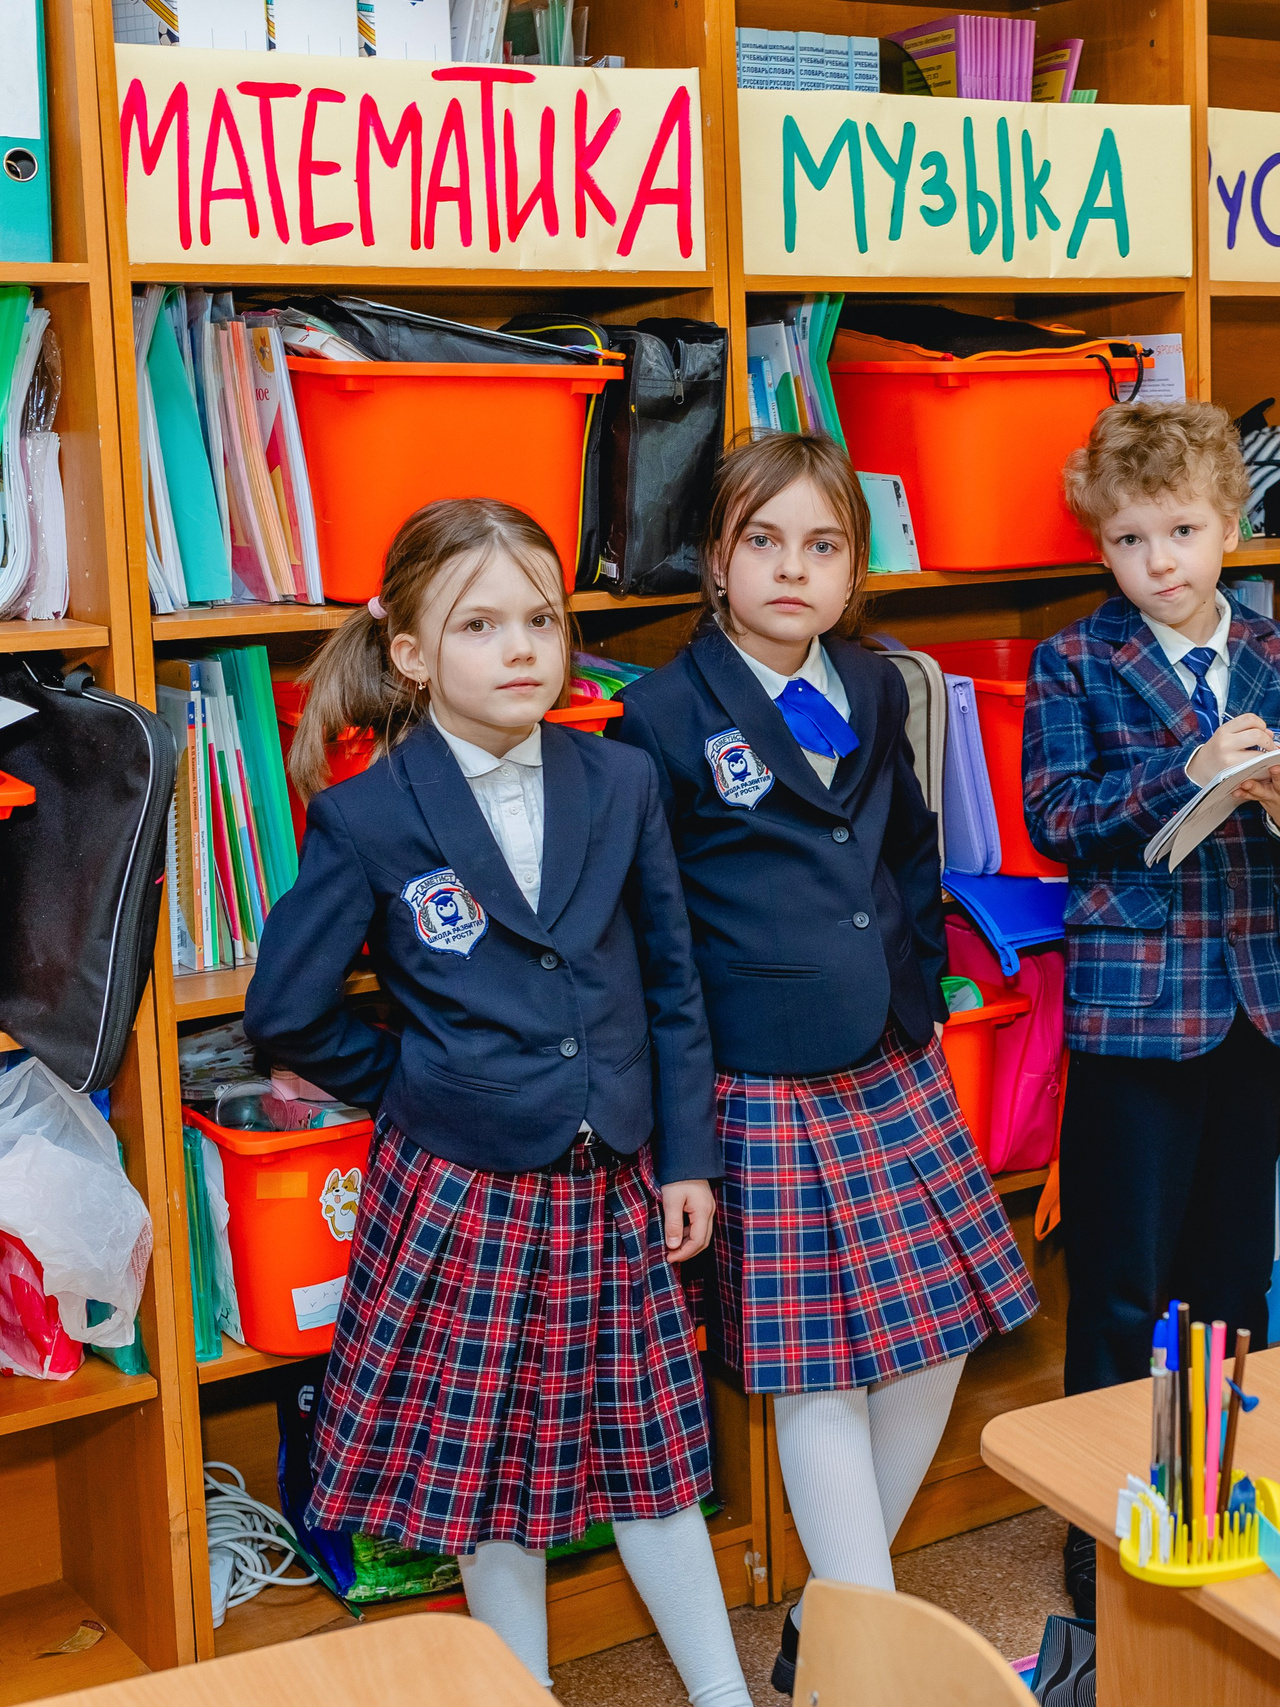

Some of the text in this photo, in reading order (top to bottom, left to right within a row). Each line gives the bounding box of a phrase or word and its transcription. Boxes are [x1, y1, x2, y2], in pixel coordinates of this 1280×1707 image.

[742, 53, 768, 62] УЧЕБНЫЙ
[768, 55, 795, 63] УЧЕБНЫЙ
[799, 57, 824, 65] УЧЕБНЫЙ
[825, 60, 849, 68] УЧЕБНЫЙ
[854, 61, 878, 69] УЧЕБНЫЙ
[742, 66, 768, 74] СЛОВАРЬ
[768, 67, 795, 75] СЛОВАРЬ
[799, 69, 825, 77] СЛОВАРЬ
[825, 72, 849, 80] СЛОВАРЬ
[854, 73, 878, 81] СЛОВАРЬ
[119, 66, 693, 258] МАТЕМАТИКА
[741, 775, 771, 789] РАЗВИТИЯ
[741, 785, 760, 796] РОСТА
[420, 875, 454, 892] АМЕТИСТ
[427, 919, 485, 944] ШКОЛА РАЗВИТИЯ
[444, 931, 474, 945] И РОСТА
